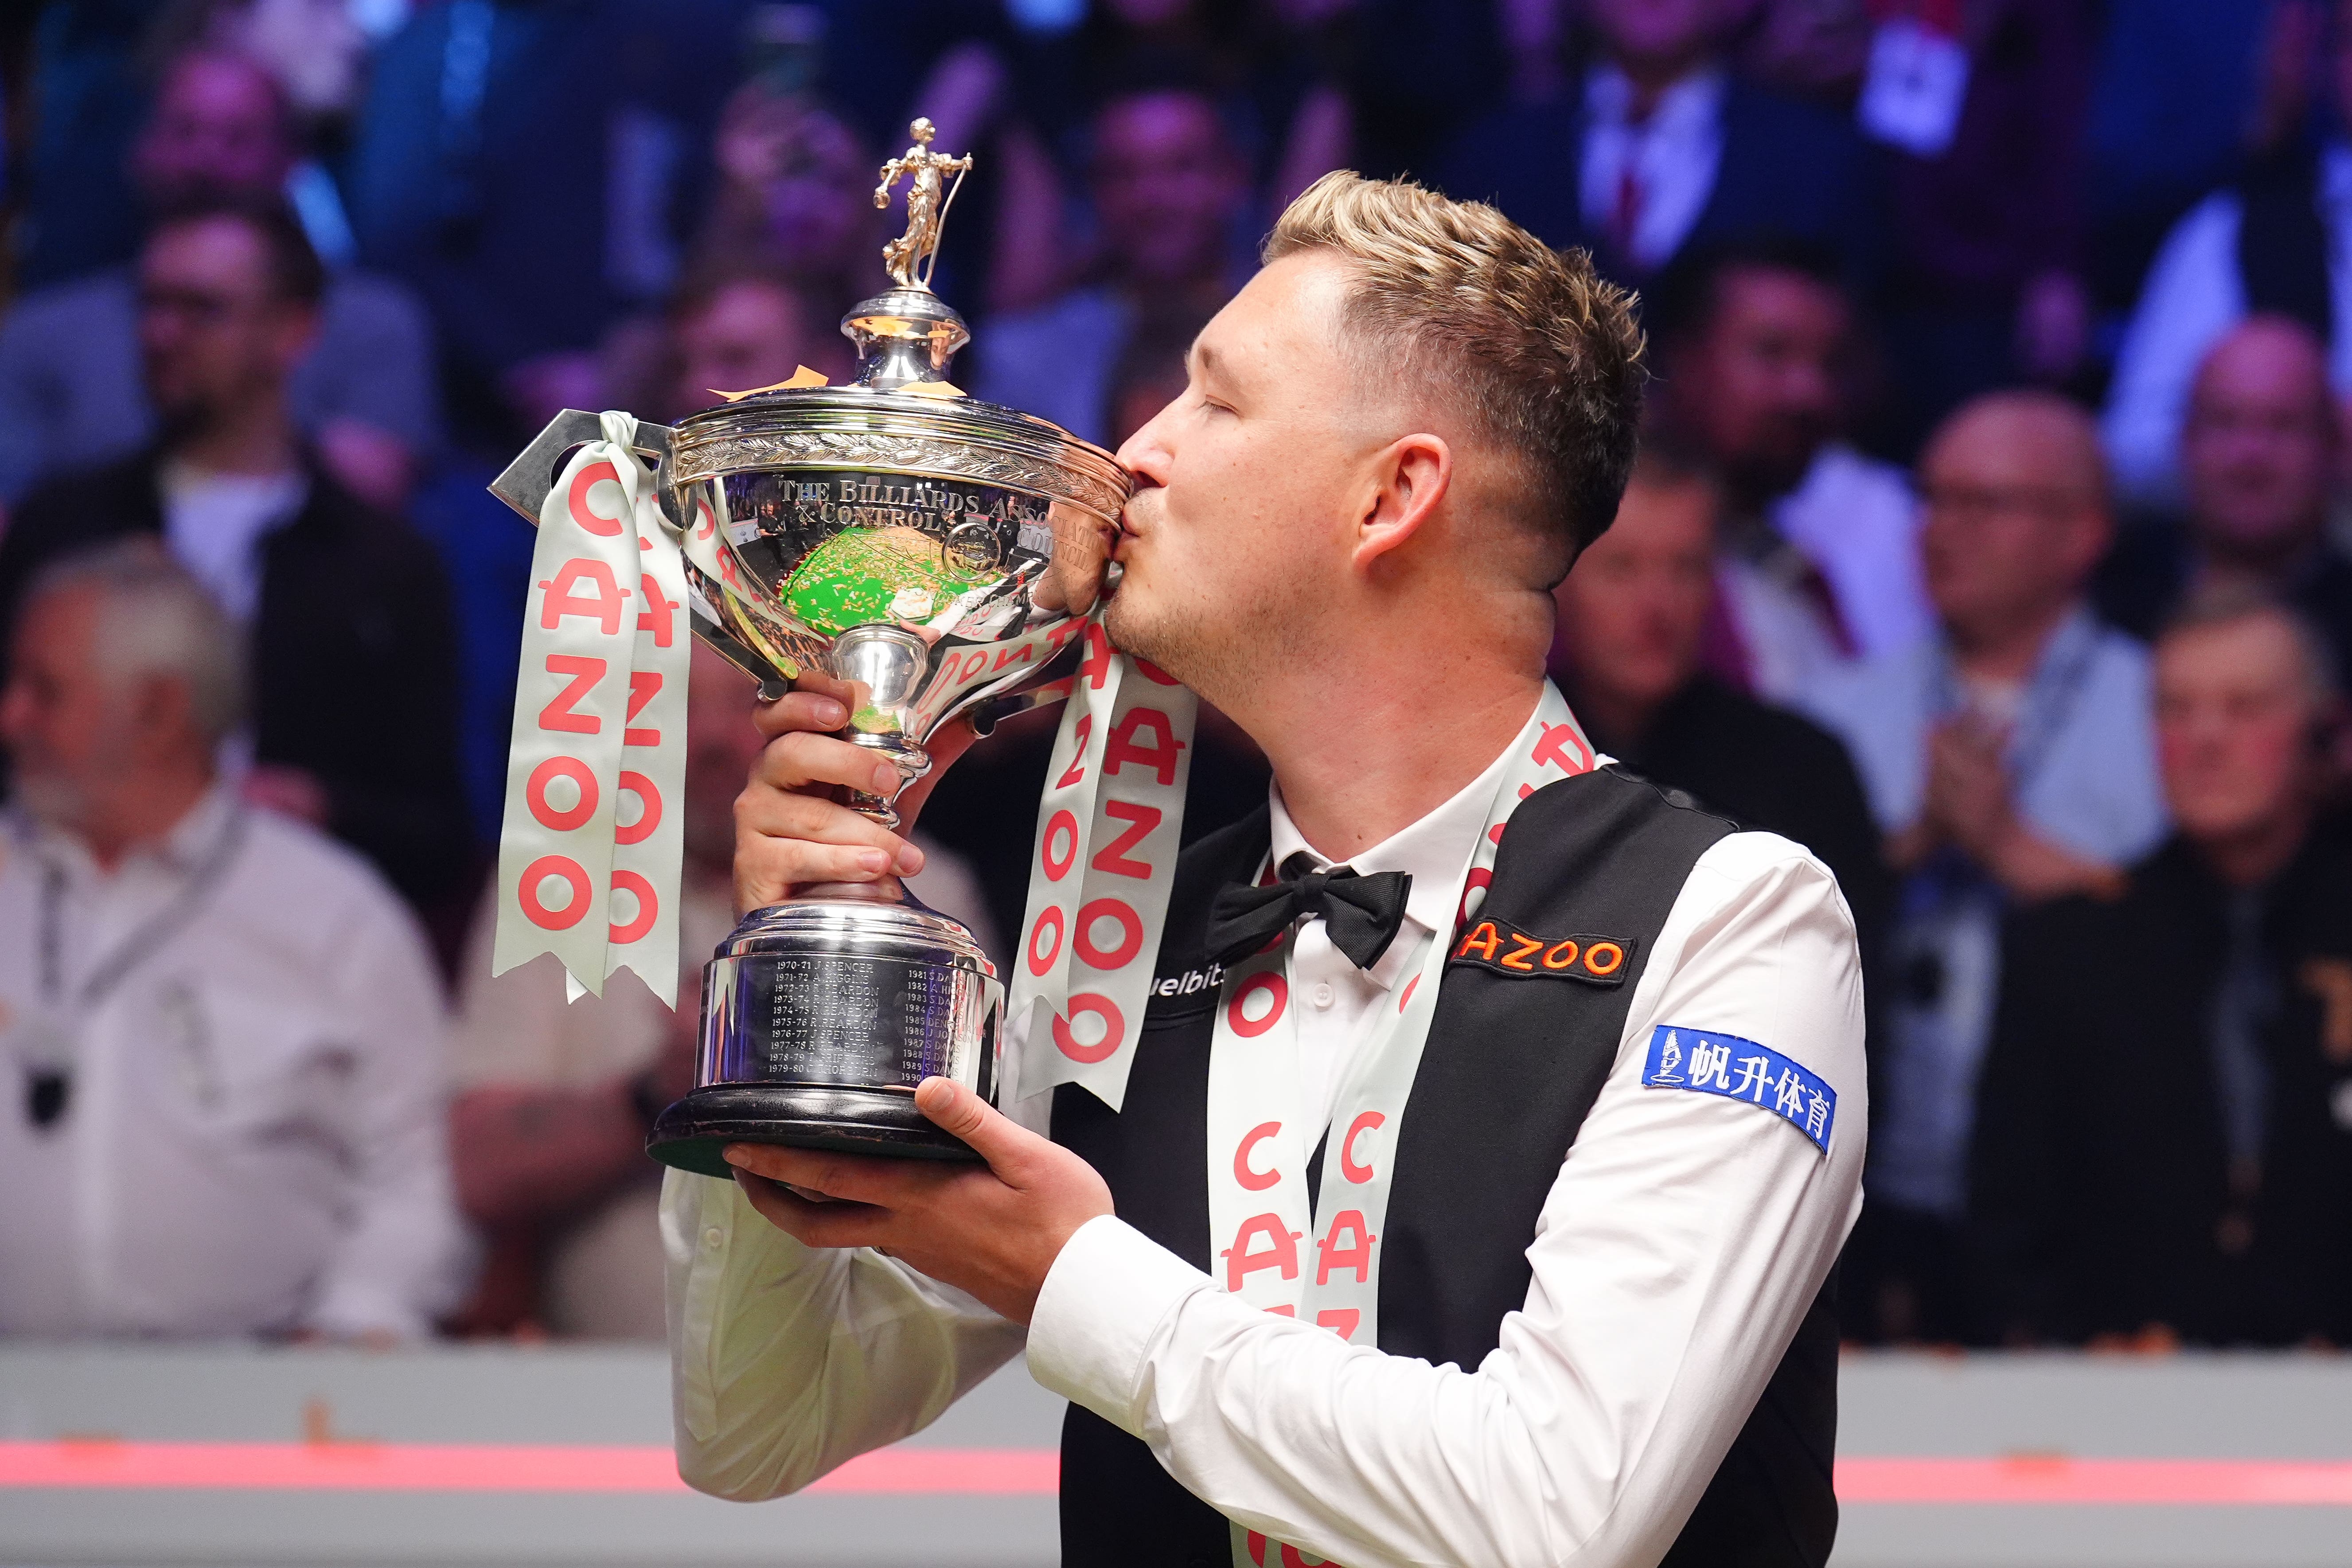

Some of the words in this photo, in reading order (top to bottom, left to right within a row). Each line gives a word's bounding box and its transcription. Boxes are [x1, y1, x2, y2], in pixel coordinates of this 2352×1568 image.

[778, 480, 830, 502] THE
[839, 480, 979, 514] BILLIARDS
[796, 505, 817, 523] &
[820, 502, 942, 531] CONTROL
[518, 461, 631, 931] CAZOO
[1028, 622, 1121, 976] AZOO
[1052, 658, 1186, 1063] AZOO
[1451, 922, 1624, 975] AZOO
[777, 961, 811, 970] 1970-71
[776, 973, 809, 982] 1971-72
[909, 970, 927, 980] 1981
[1149, 962, 1226, 997] elbit
[775, 984, 810, 993] 1972-73
[908, 982, 928, 992] 1982
[774, 995, 810, 1003] 1973-74
[907, 993, 927, 1002] 1983
[773, 1006, 810, 1014] 1974-75
[905, 1004, 926, 1014] 1984
[772, 1018, 807, 1027] 1975-76
[905, 1015, 925, 1025] 1985
[928, 1018, 958, 1030] DENS
[772, 1030, 808, 1038] 1976-77
[905, 1026, 925, 1036] 1986
[937, 1030, 972, 1043] JONSON
[771, 1041, 807, 1050] 1977-78
[904, 1038, 924, 1048] 1987
[934, 1041, 961, 1053] DAVIS
[769, 1053, 805, 1062] 1978-79
[903, 1049, 923, 1059] 1988
[933, 1053, 960, 1065] DAVIS
[769, 1065, 804, 1073] 1979-80
[902, 1061, 922, 1070] 1989
[933, 1064, 959, 1077] DAVIS
[901, 1073, 922, 1082] 1990
[1688, 1039, 1831, 1139] 帆升体育
